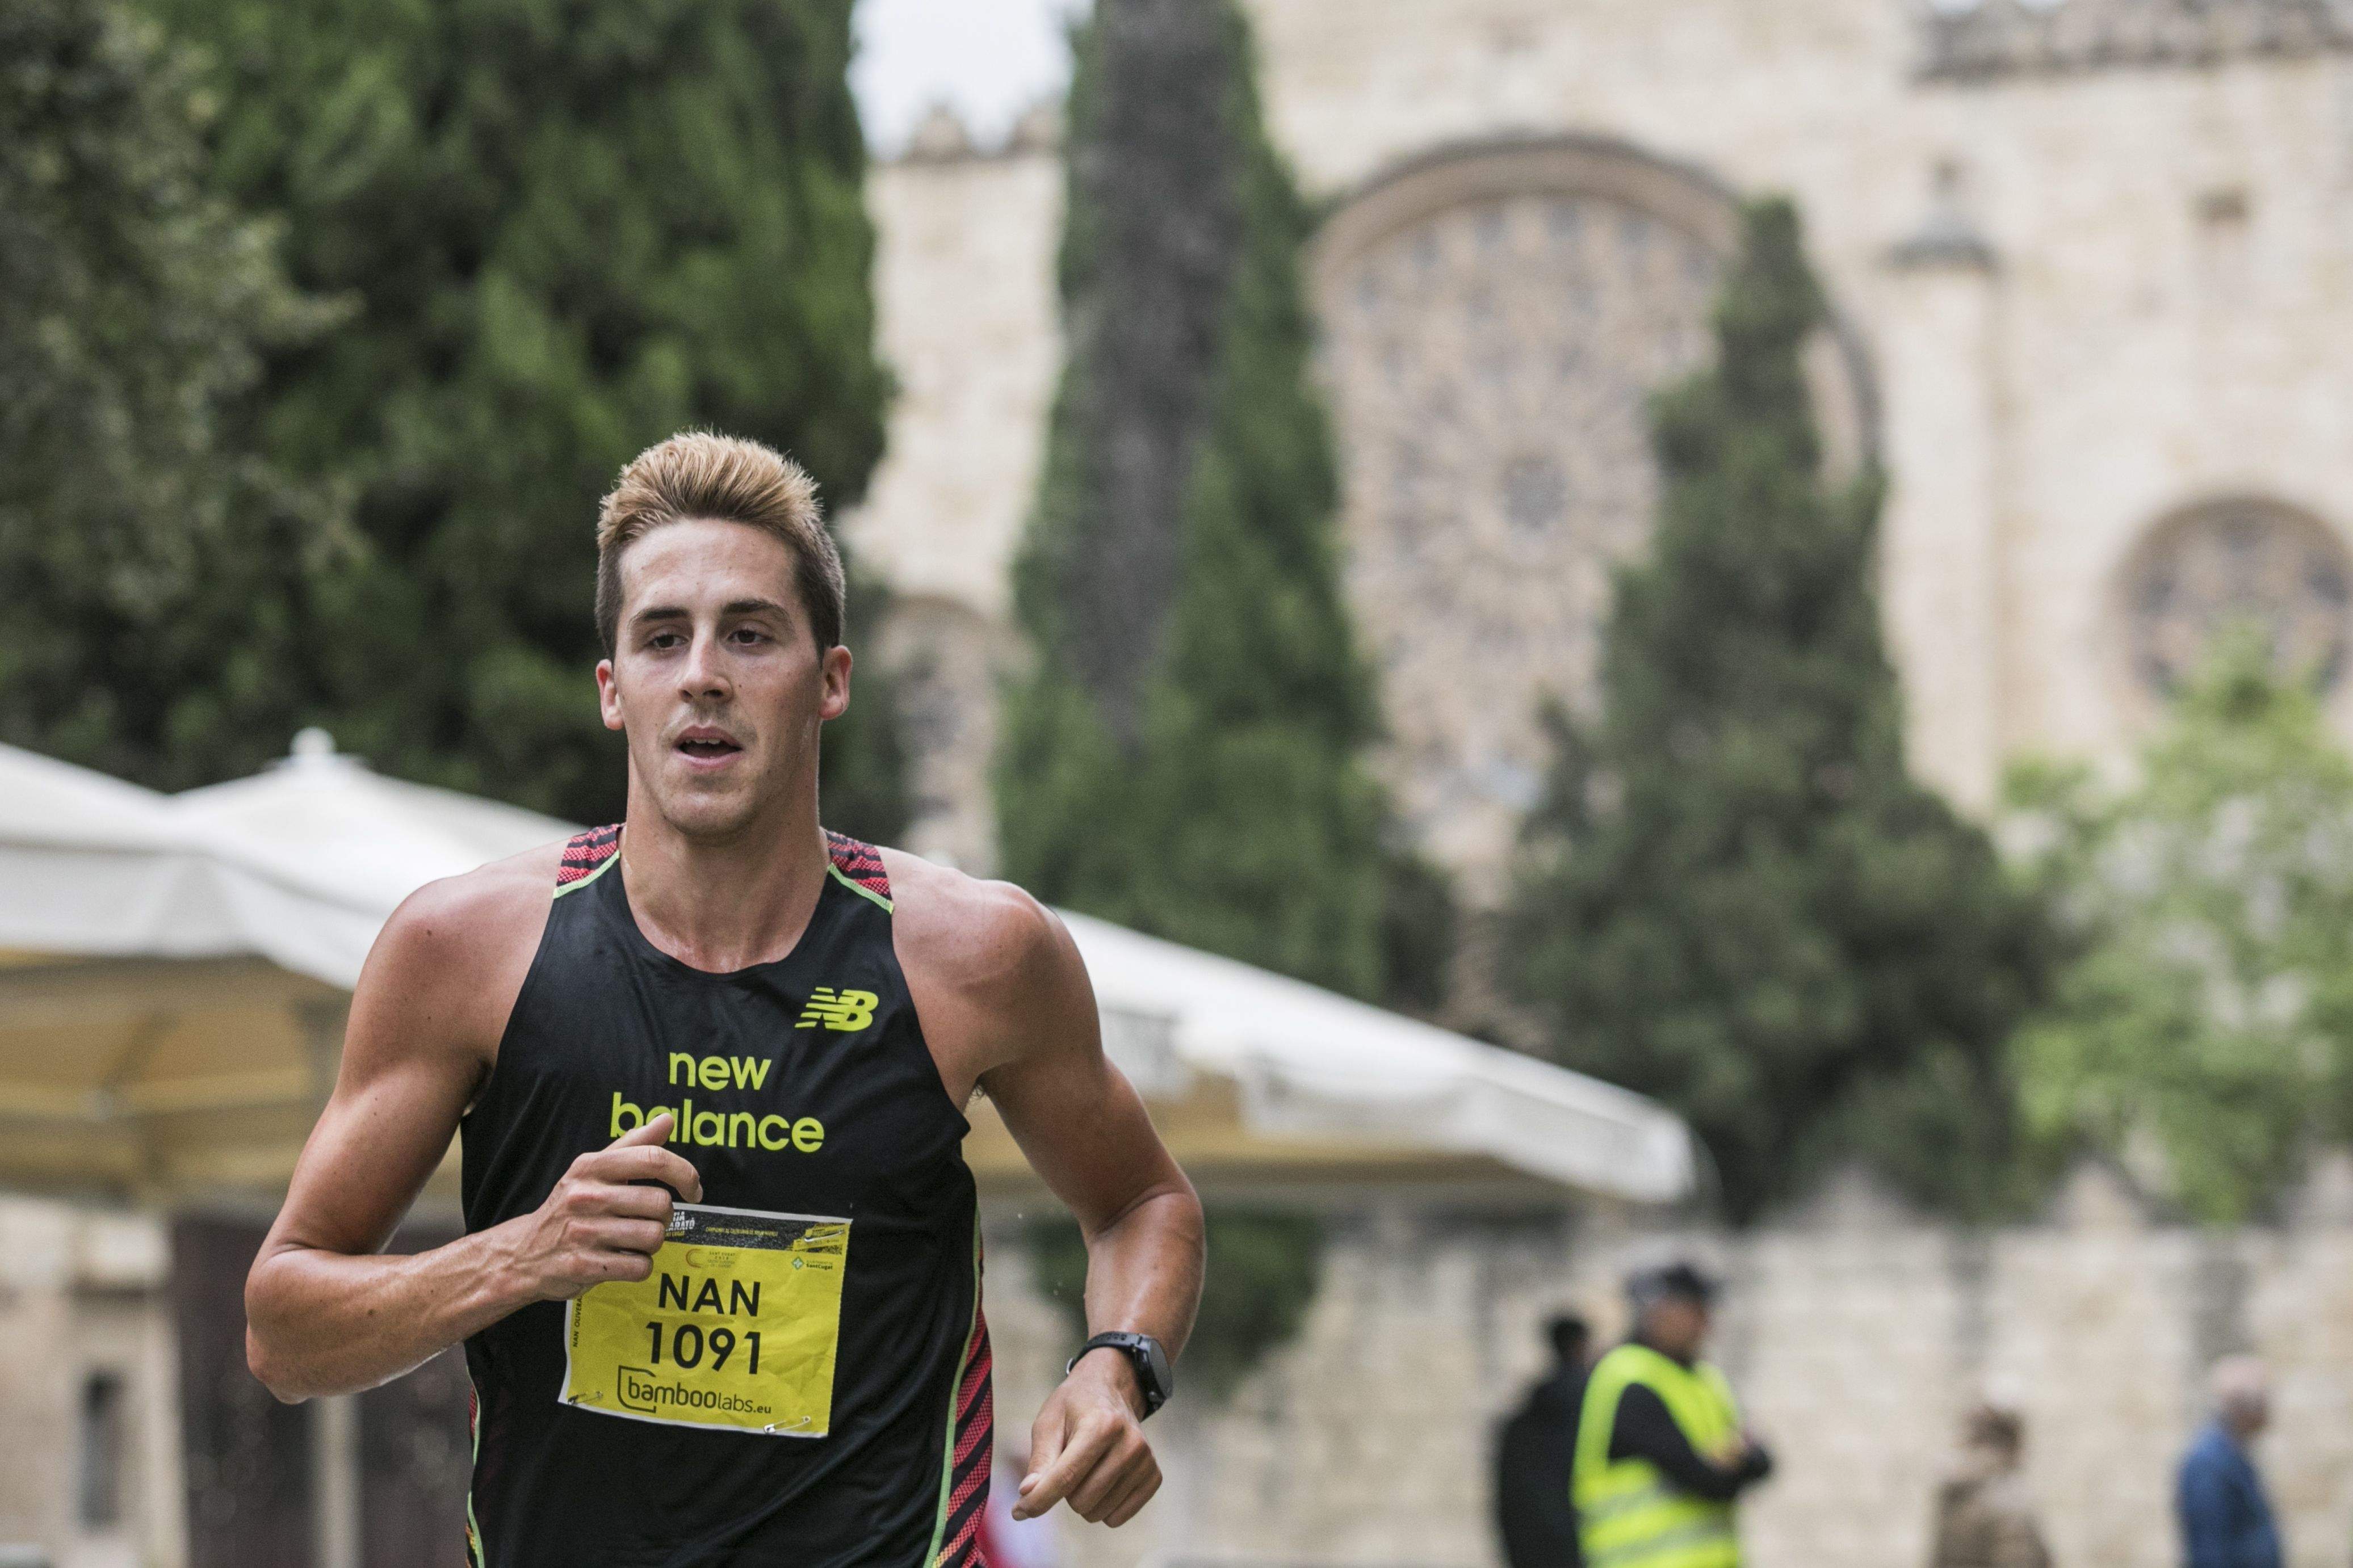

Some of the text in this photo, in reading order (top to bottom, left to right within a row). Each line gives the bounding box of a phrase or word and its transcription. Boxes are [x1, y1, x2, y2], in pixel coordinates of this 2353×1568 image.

[669, 1052, 771, 1090] new
[658, 1273, 761, 1317] NAN
[645, 1321, 761, 1374] 1091
[628, 1376, 771, 1414] bamboolabs.eu
